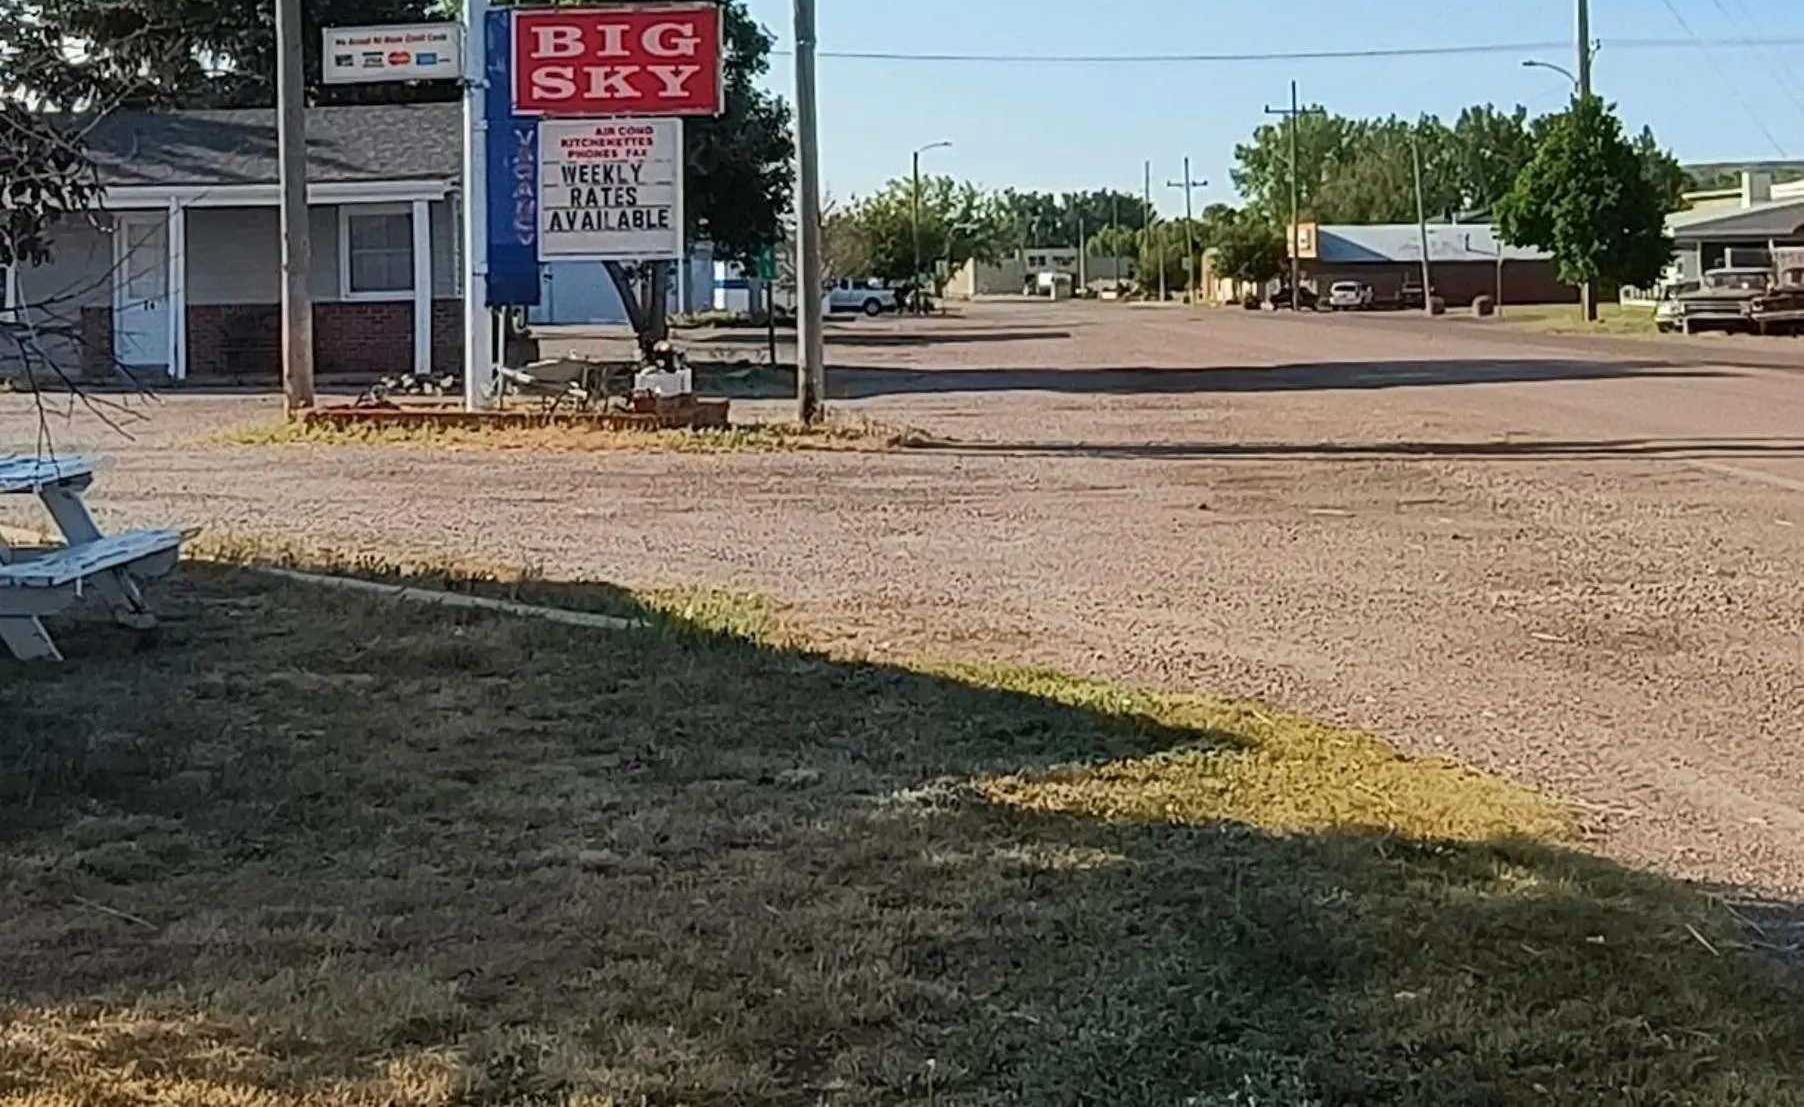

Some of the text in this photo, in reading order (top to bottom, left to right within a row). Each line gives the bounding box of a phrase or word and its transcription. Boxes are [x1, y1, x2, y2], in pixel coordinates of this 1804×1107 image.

[530, 22, 701, 58] BIG
[531, 64, 700, 100] SKY
[595, 125, 655, 136] AIR COND
[560, 136, 654, 148] KITCHENETTES
[567, 148, 648, 159] PHONES FAX
[561, 163, 643, 184] WEEKLY
[570, 186, 638, 208] RATES
[550, 208, 670, 232] AVAILABLE
